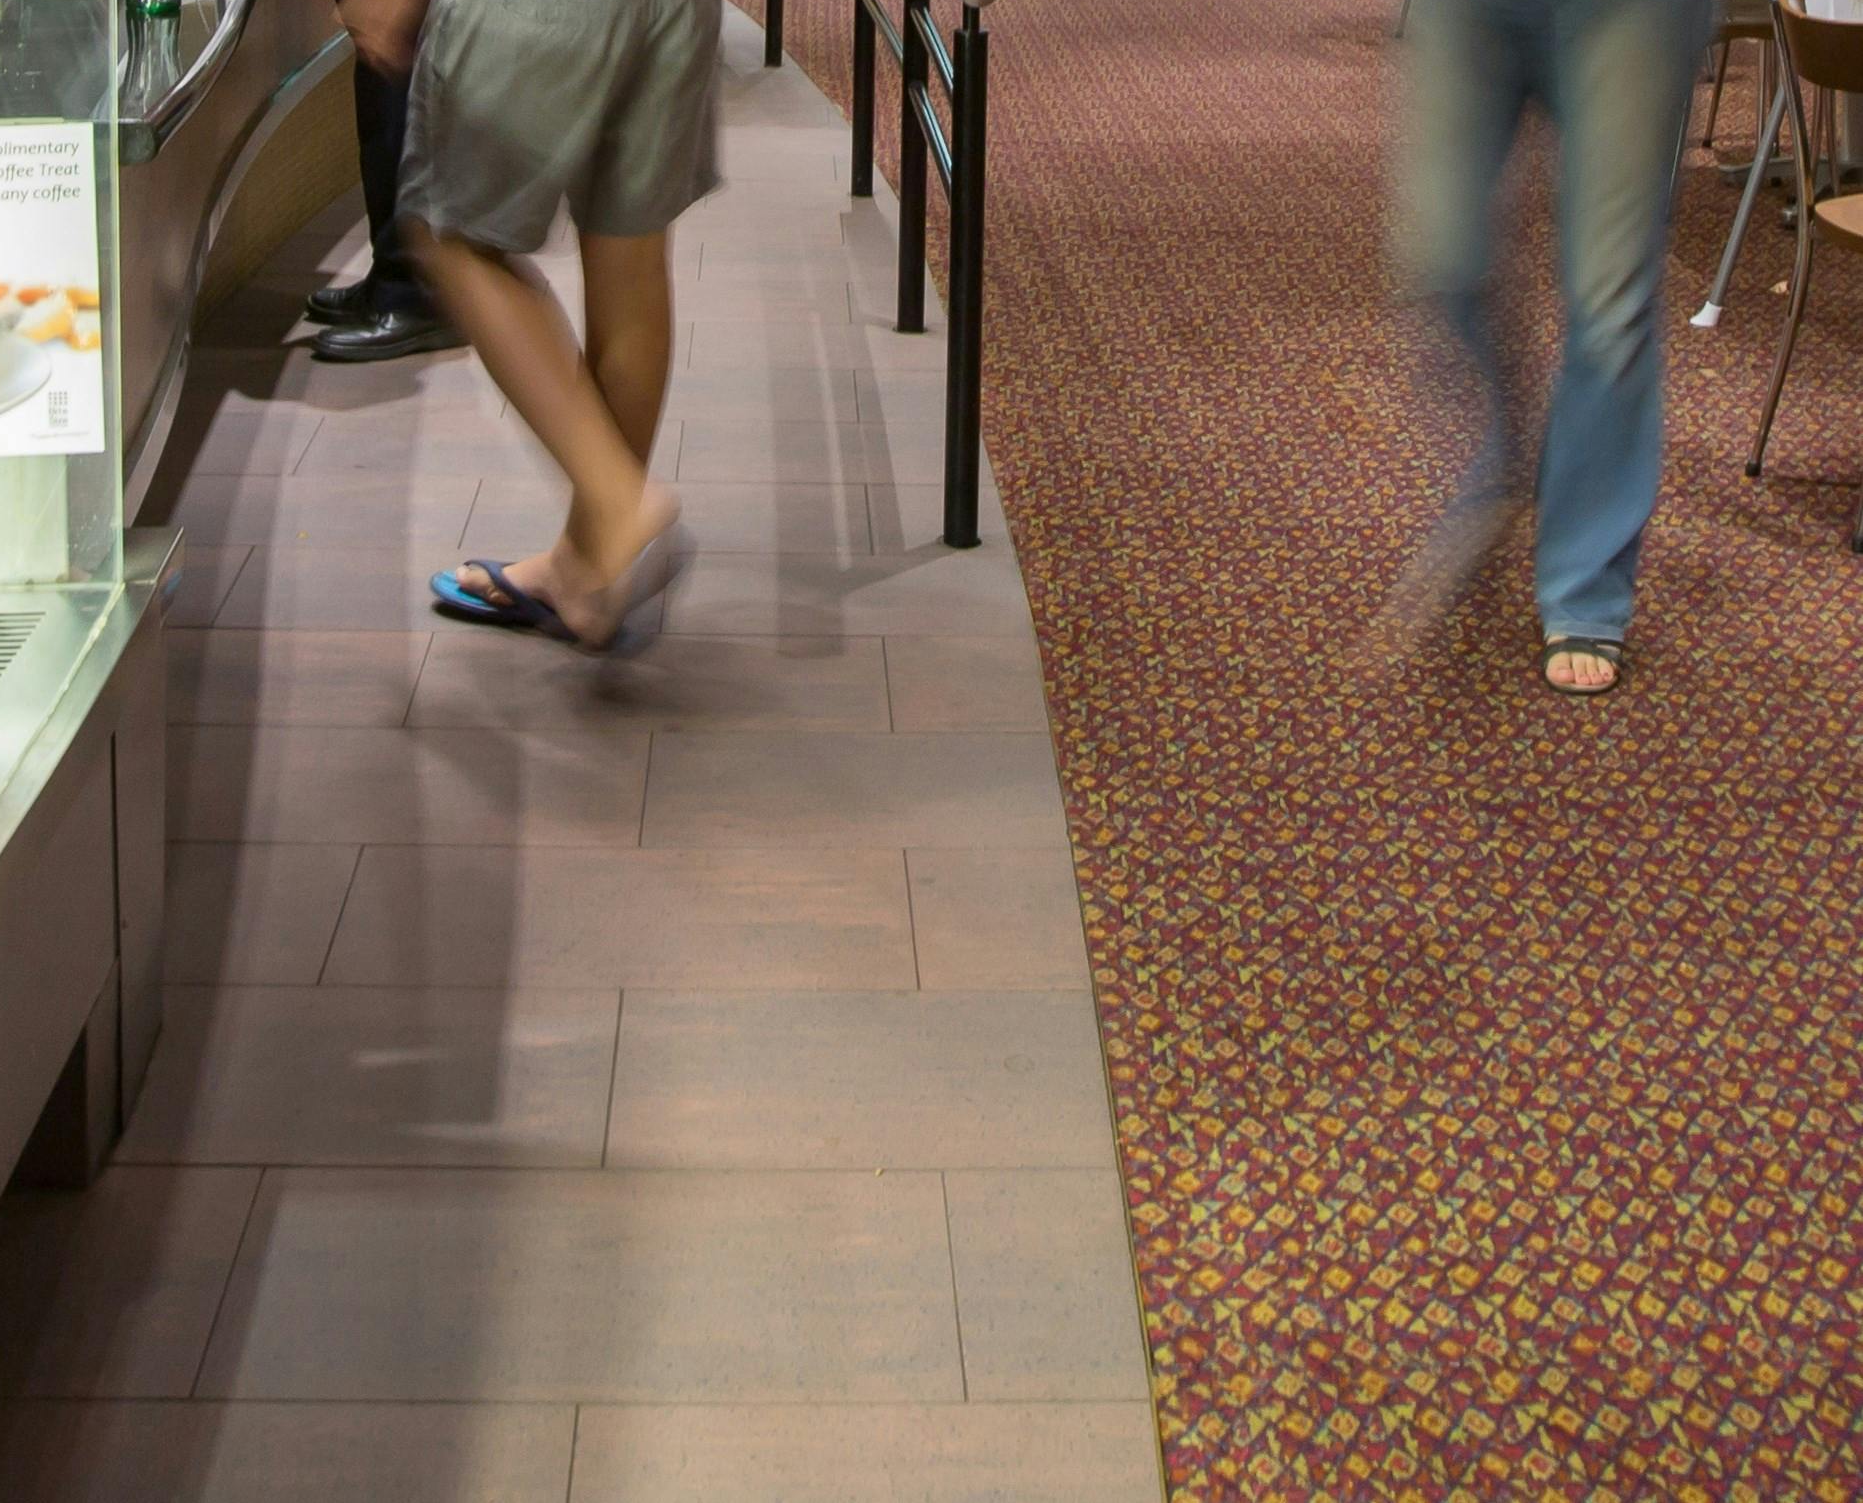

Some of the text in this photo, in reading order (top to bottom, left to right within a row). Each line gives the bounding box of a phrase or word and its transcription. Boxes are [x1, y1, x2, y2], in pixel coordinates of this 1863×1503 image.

[39, 163, 80, 177] Treat
[1, 189, 29, 204] any
[32, 184, 81, 202] coffee
